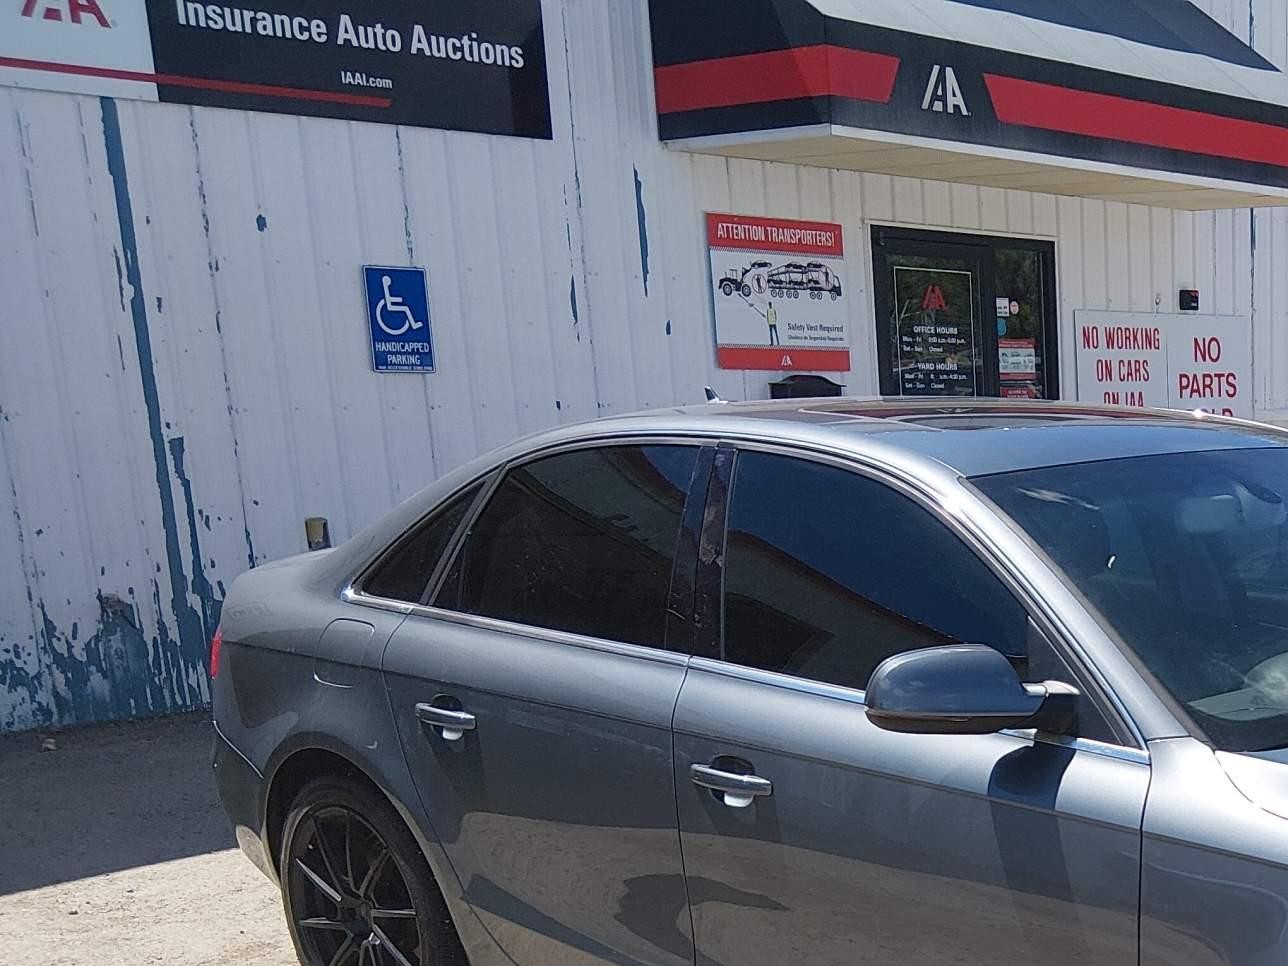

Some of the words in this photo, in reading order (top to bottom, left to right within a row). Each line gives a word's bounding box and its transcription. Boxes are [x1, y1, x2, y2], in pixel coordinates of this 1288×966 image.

[175, 0, 327, 43] Insurance
[337, 14, 401, 52] Auto
[410, 24, 525, 69] Auctions
[341, 70, 393, 90] IAAI.com
[717, 222, 765, 241] ATTENTION
[767, 227, 835, 247] TRANSPORTERS!
[787, 322, 805, 333] Safety
[819, 324, 844, 333] Required
[913, 325, 935, 334] OFFICE
[936, 326, 958, 335] HOURS
[1082, 326, 1099, 350] NO
[1104, 327, 1160, 350] WORKING
[375, 341, 430, 352] HANDICAPPED
[1193, 337, 1221, 363] NO
[387, 354, 421, 365] PARKING
[917, 362, 935, 371] YARD
[936, 362, 958, 371] HOURS
[1096, 359, 1112, 382] ON
[1118, 359, 1150, 382] CARS
[1178, 372, 1237, 399] PARTS
